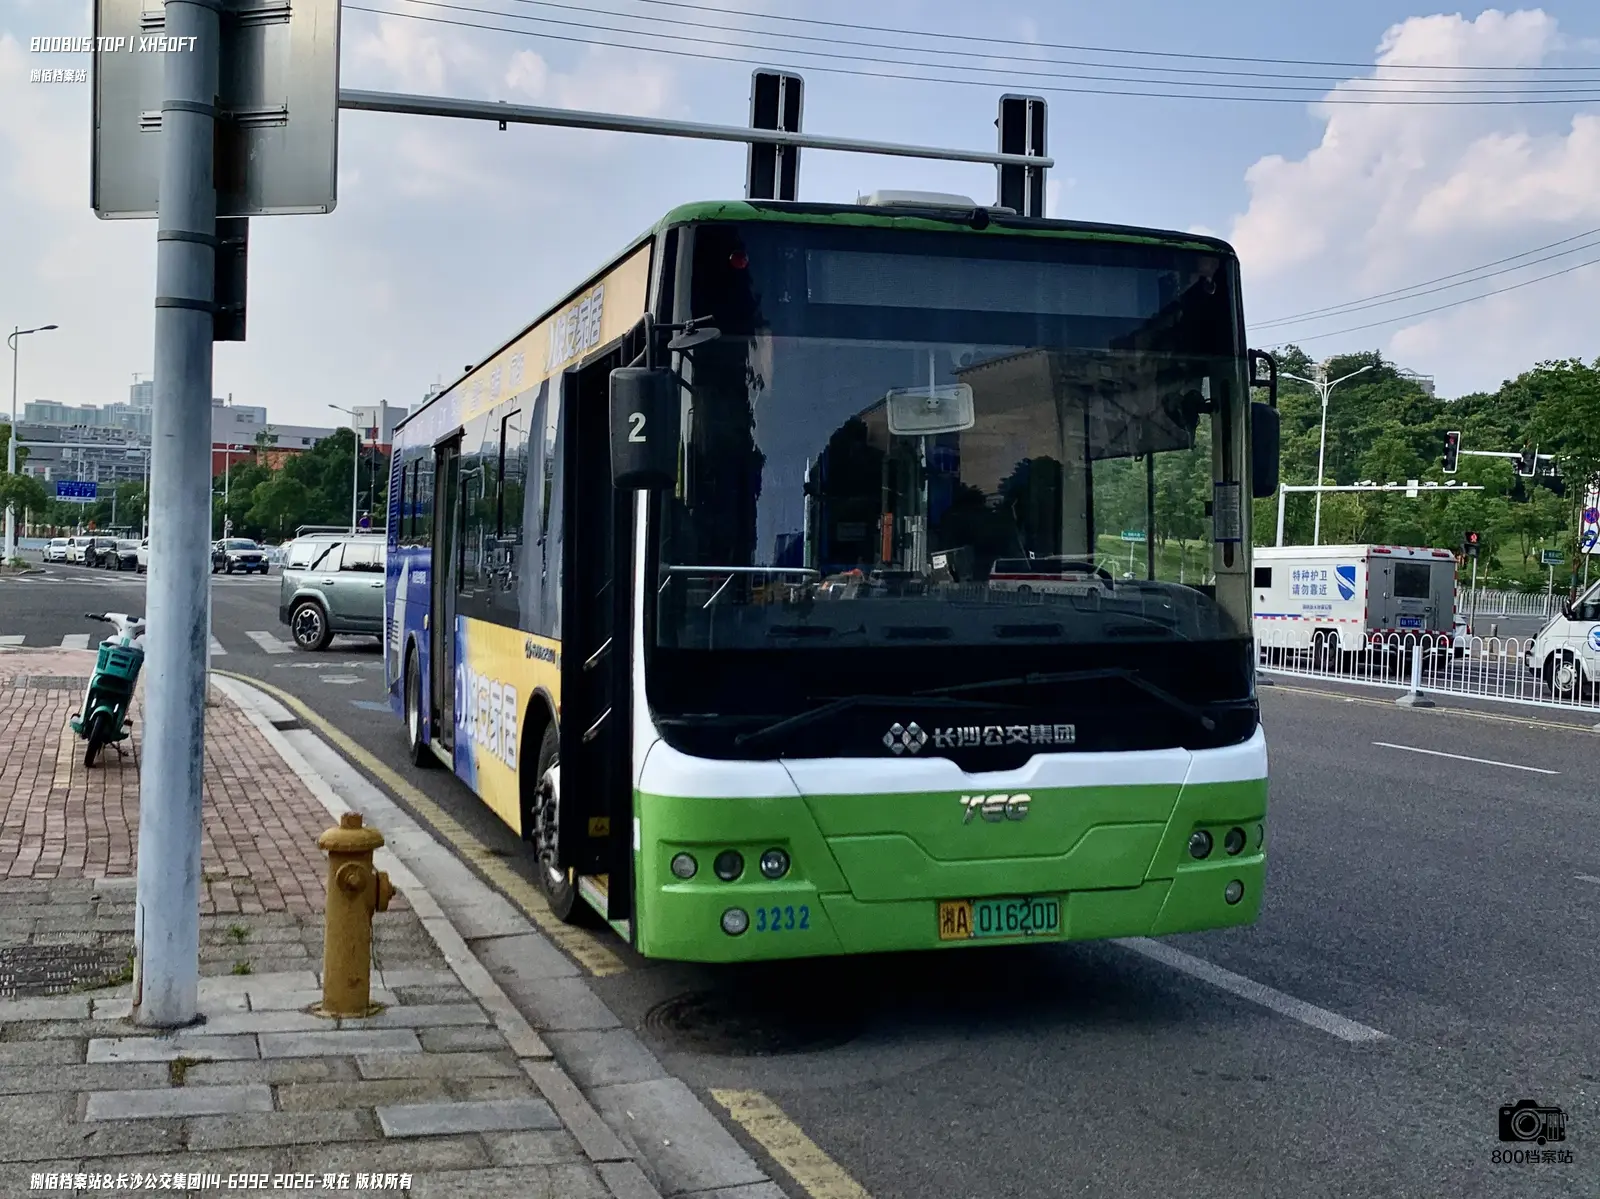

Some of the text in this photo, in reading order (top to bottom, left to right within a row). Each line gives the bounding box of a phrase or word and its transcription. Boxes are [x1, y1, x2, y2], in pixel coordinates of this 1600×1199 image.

[628, 412, 646, 442] 2
[1292, 569, 1328, 582] 特种护卫
[1292, 583, 1328, 596] 请勿靠近
[932, 724, 1076, 748] 长沙公交集团
[756, 905, 811, 932] 3232
